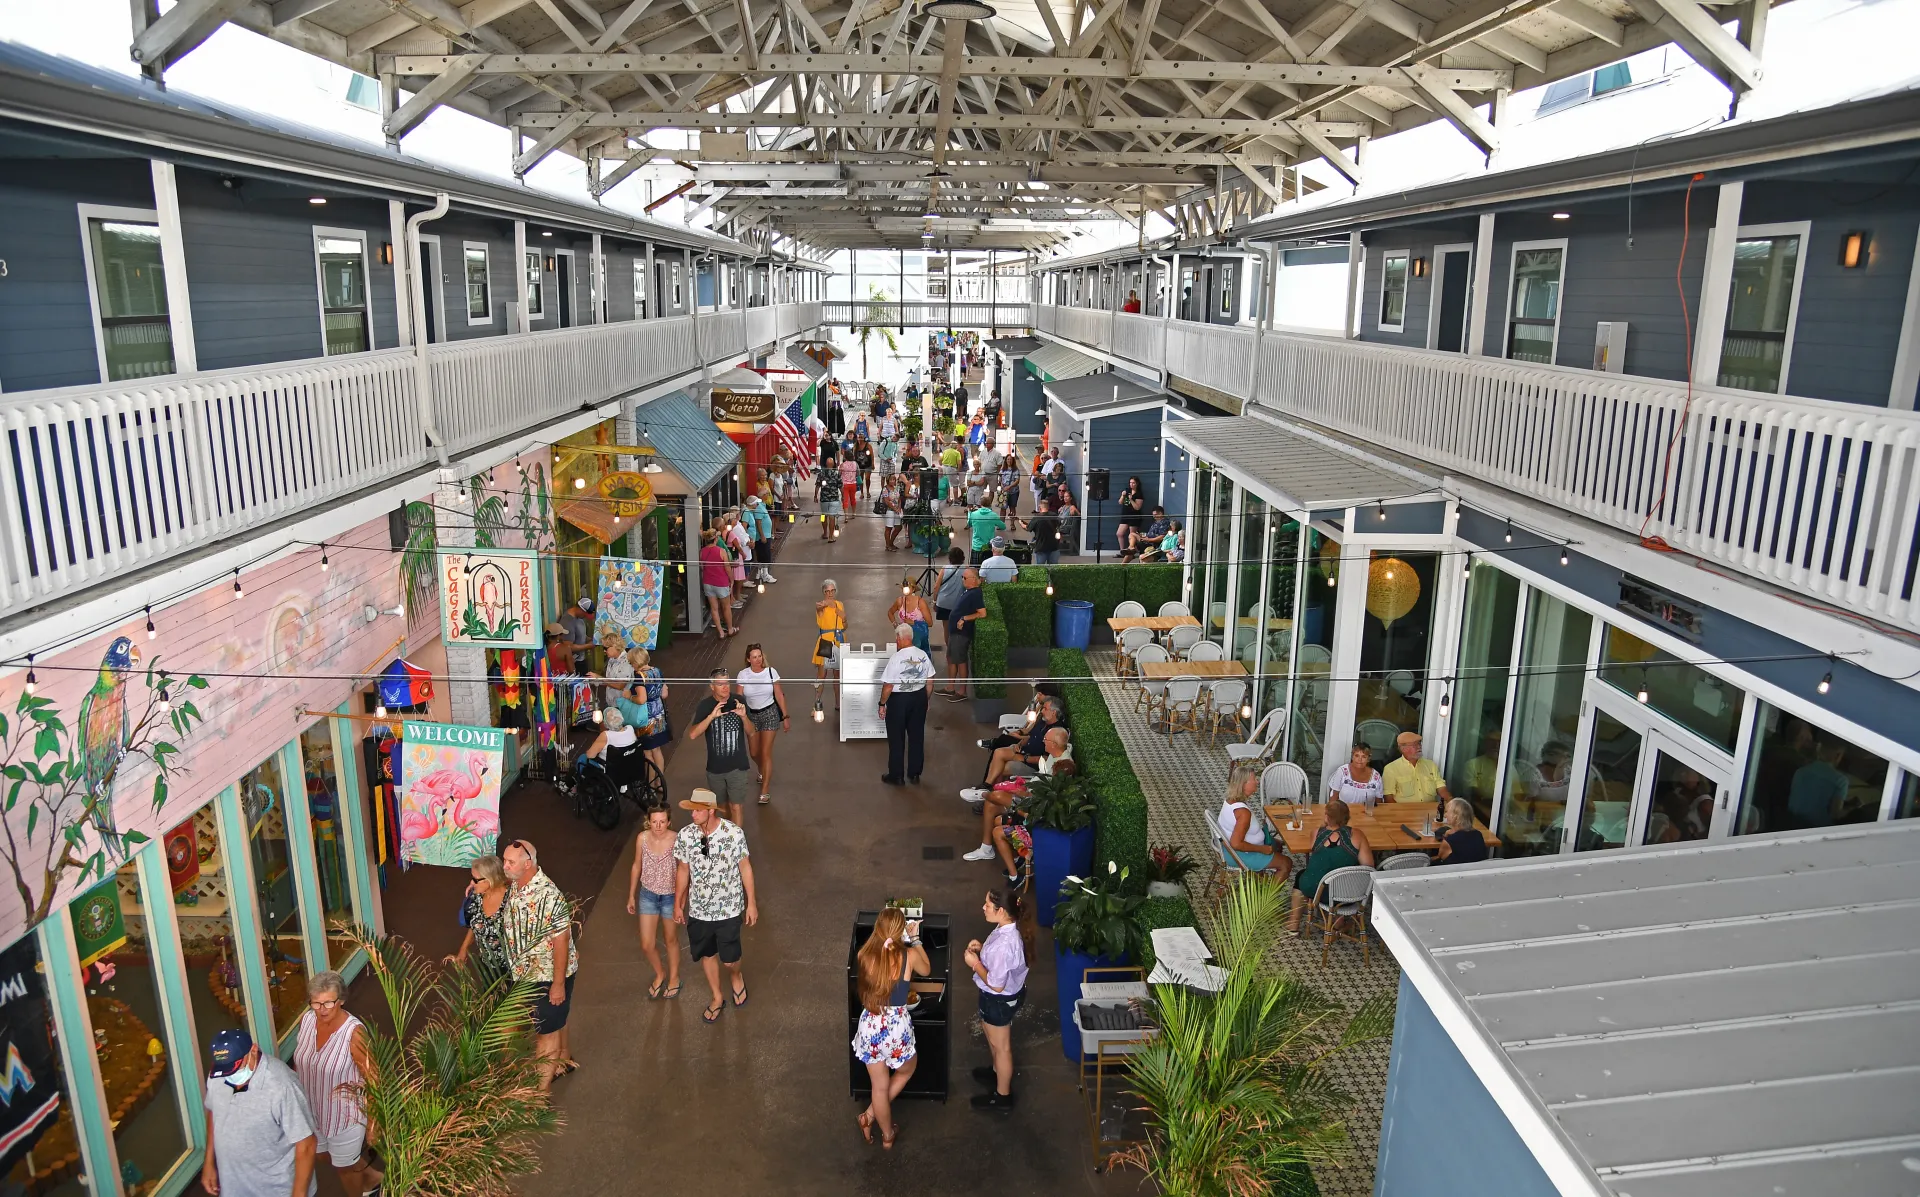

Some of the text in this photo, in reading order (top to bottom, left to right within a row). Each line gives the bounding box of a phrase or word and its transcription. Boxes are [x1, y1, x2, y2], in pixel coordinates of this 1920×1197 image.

[725, 394, 763, 404] Pirates
[730, 403, 760, 413] Ketch
[604, 475, 645, 493] WASH
[446, 556, 461, 564] The
[407, 724, 500, 747] WELCOME
